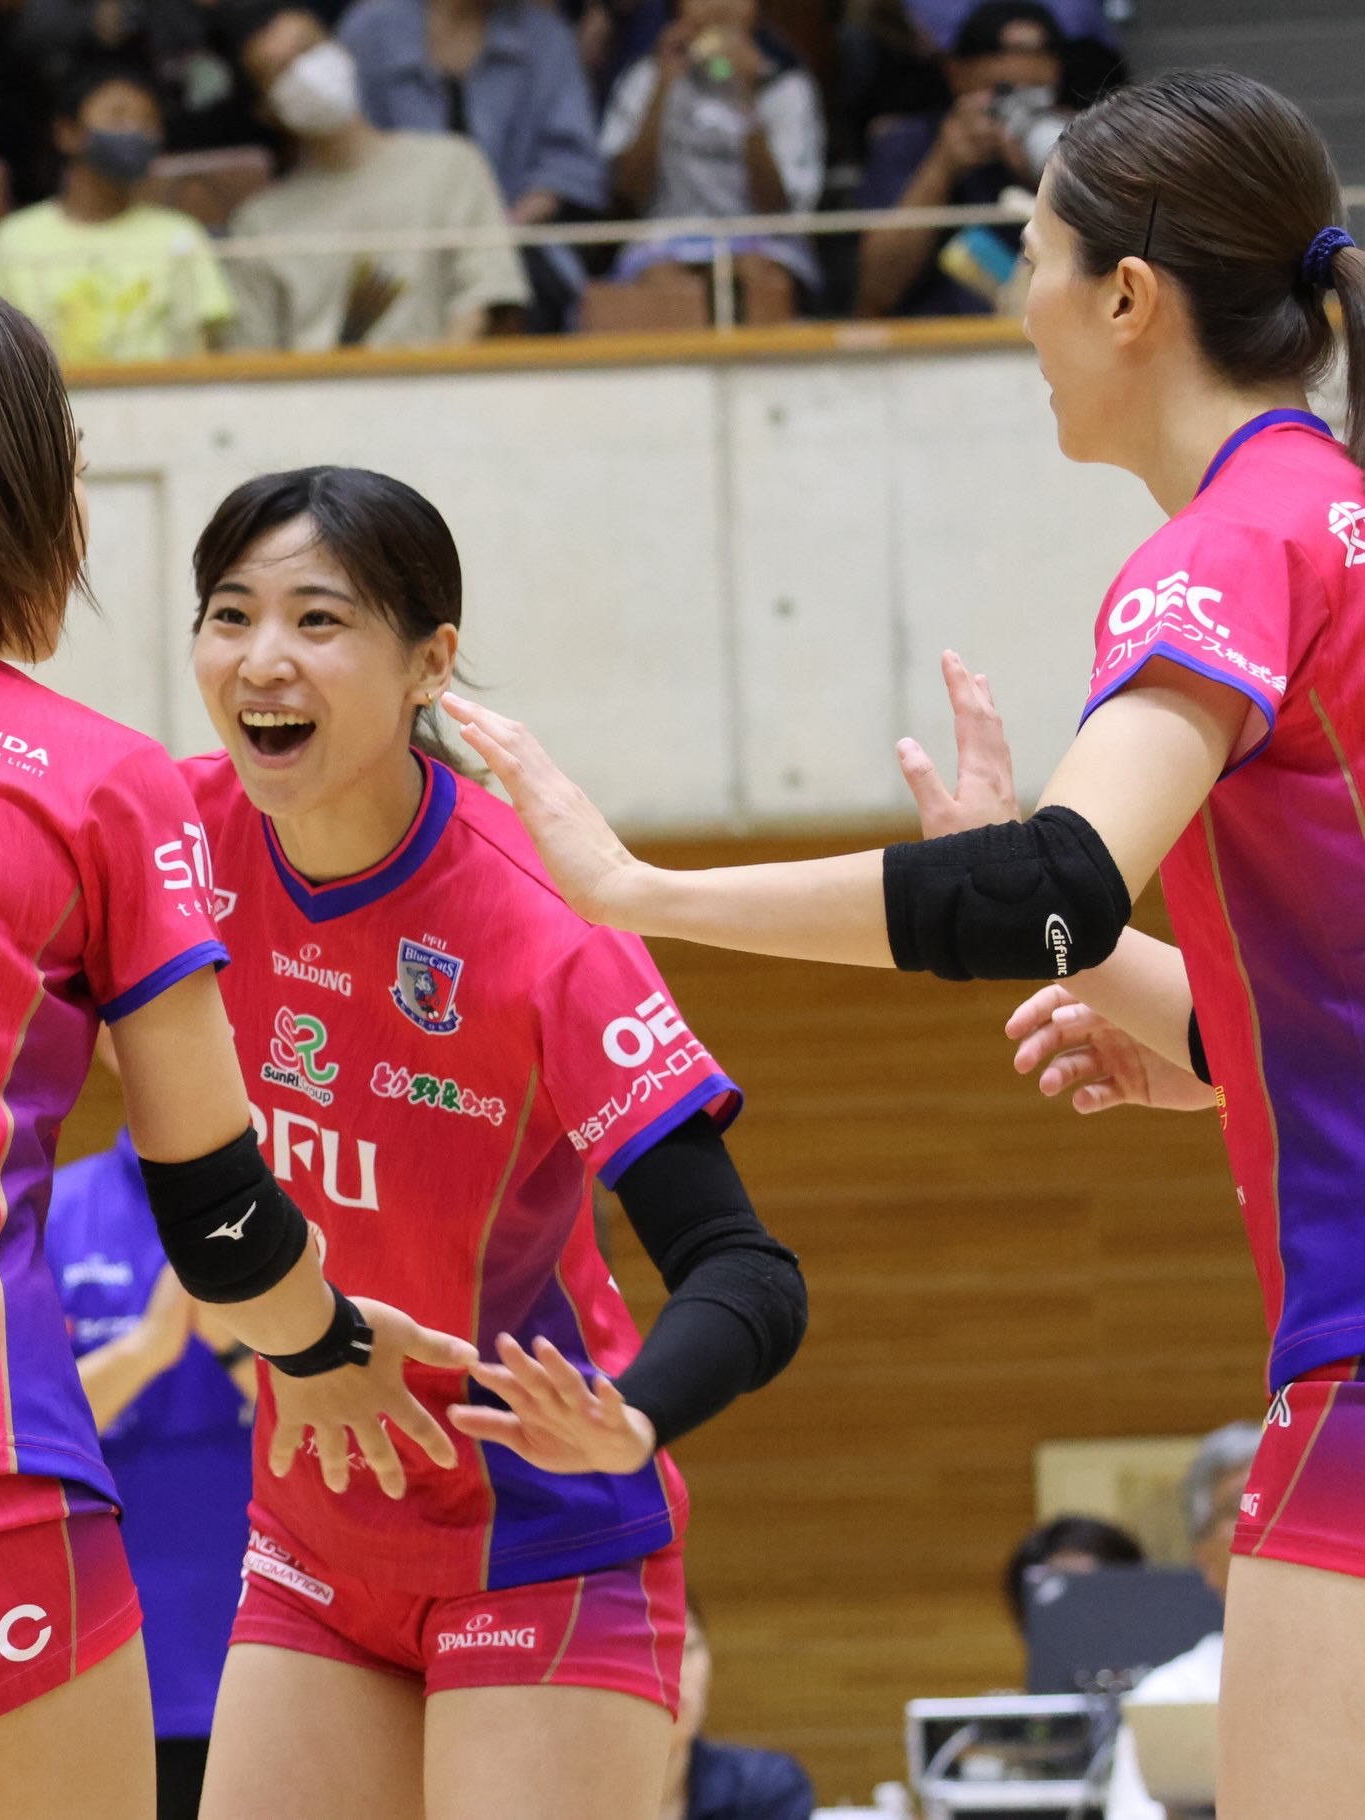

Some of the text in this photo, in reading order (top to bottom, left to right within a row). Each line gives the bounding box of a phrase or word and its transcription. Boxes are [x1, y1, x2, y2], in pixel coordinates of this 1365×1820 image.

[7, 756, 46, 778] LIMIT
[421, 932, 447, 951] PFU
[272, 950, 352, 998] SPALDING
[437, 1626, 536, 1654] SPALDING
